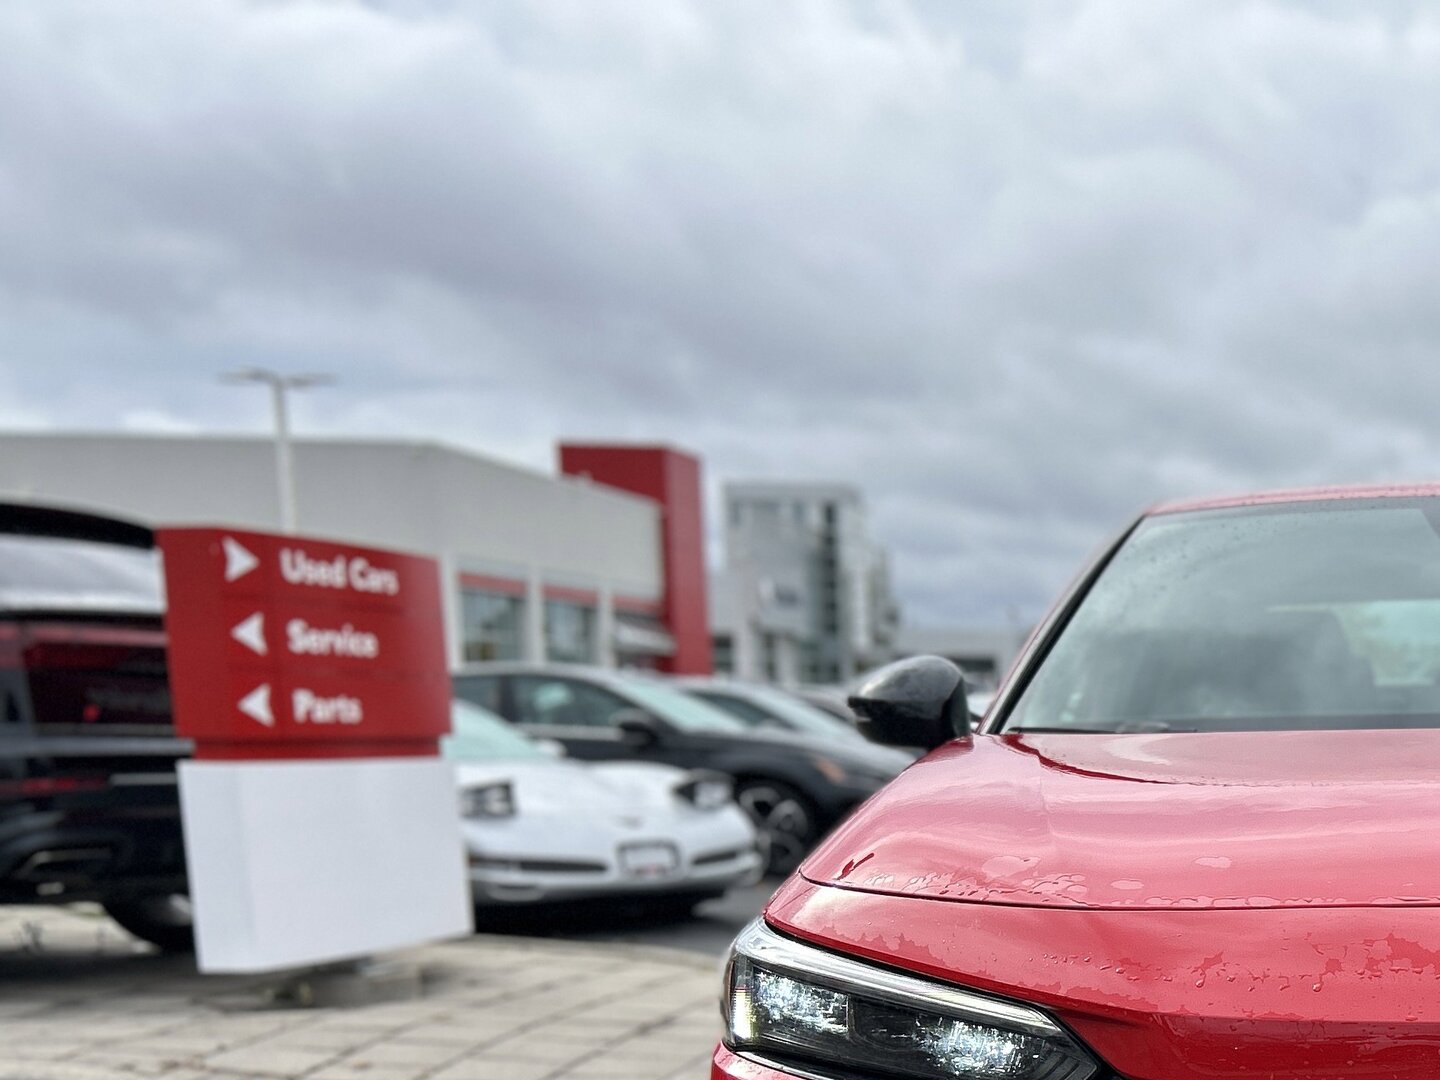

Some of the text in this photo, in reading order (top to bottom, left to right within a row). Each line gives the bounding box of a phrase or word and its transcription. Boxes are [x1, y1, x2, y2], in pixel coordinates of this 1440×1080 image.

[280, 547, 398, 595] Used Cars
[287, 619, 379, 658] Service
[292, 688, 363, 724] Parts
